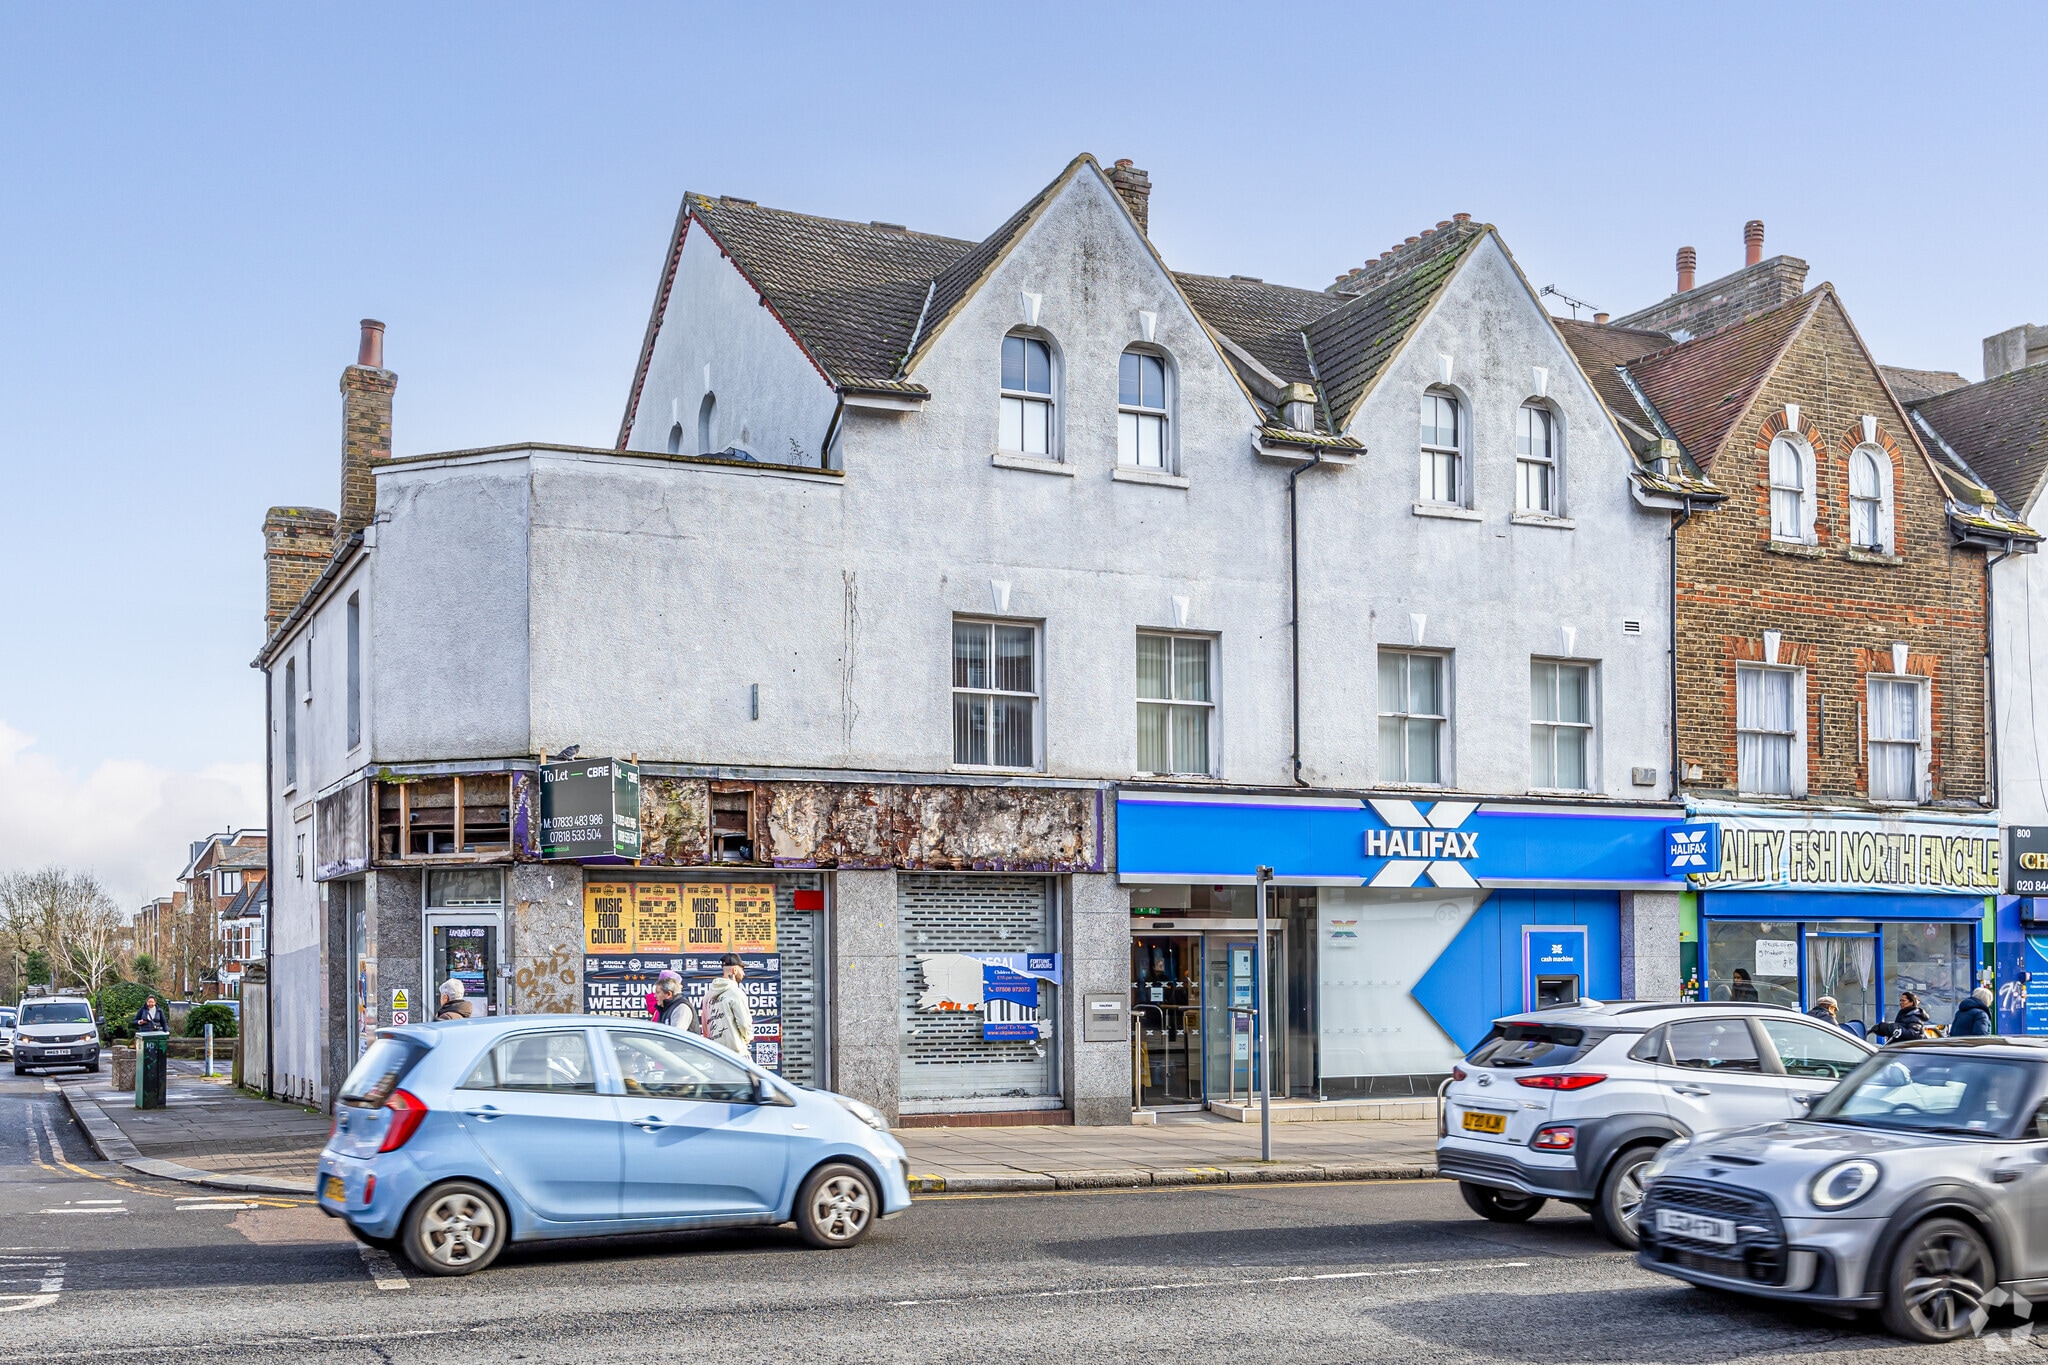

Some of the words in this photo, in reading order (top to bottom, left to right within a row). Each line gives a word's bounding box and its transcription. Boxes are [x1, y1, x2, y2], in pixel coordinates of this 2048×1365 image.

[543, 770, 554, 782] To
[555, 769, 568, 782] Let
[586, 766, 609, 778] CBRE
[552, 816, 573, 828] 07833
[574, 815, 588, 826] 483
[589, 814, 603, 825] 986
[550, 829, 571, 843] 07818
[572, 829, 585, 841] 533
[586, 828, 601, 840] 504
[2016, 829, 2031, 838] 800
[1366, 829, 1479, 858] HALIFAX
[1670, 843, 1707, 855] HALIFAX
[1688, 829, 1784, 887] ALITY
[1790, 830, 1836, 883] FISH
[1842, 831, 1915, 884] NORTH
[1921, 835, 1998, 888] FINCHLE
[2019, 852, 2048, 870] CH
[2016, 880, 2033, 891] 020
[594, 897, 623, 913] MUSIC
[692, 897, 719, 913] MUSIC
[598, 913, 619, 928] FOOD
[695, 913, 716, 928] FOOD
[591, 928, 626, 944] CULTURE
[688, 928, 723, 943] CULTURE
[587, 983, 619, 996] THE
[621, 983, 657, 996] JUN
[687, 983, 711, 996] TH
[742, 983, 778, 995] NGLE
[588, 997, 649, 1010] WEEKEN
[588, 1010, 653, 1018] AMSTER
[753, 1026, 778, 1035] 2025
